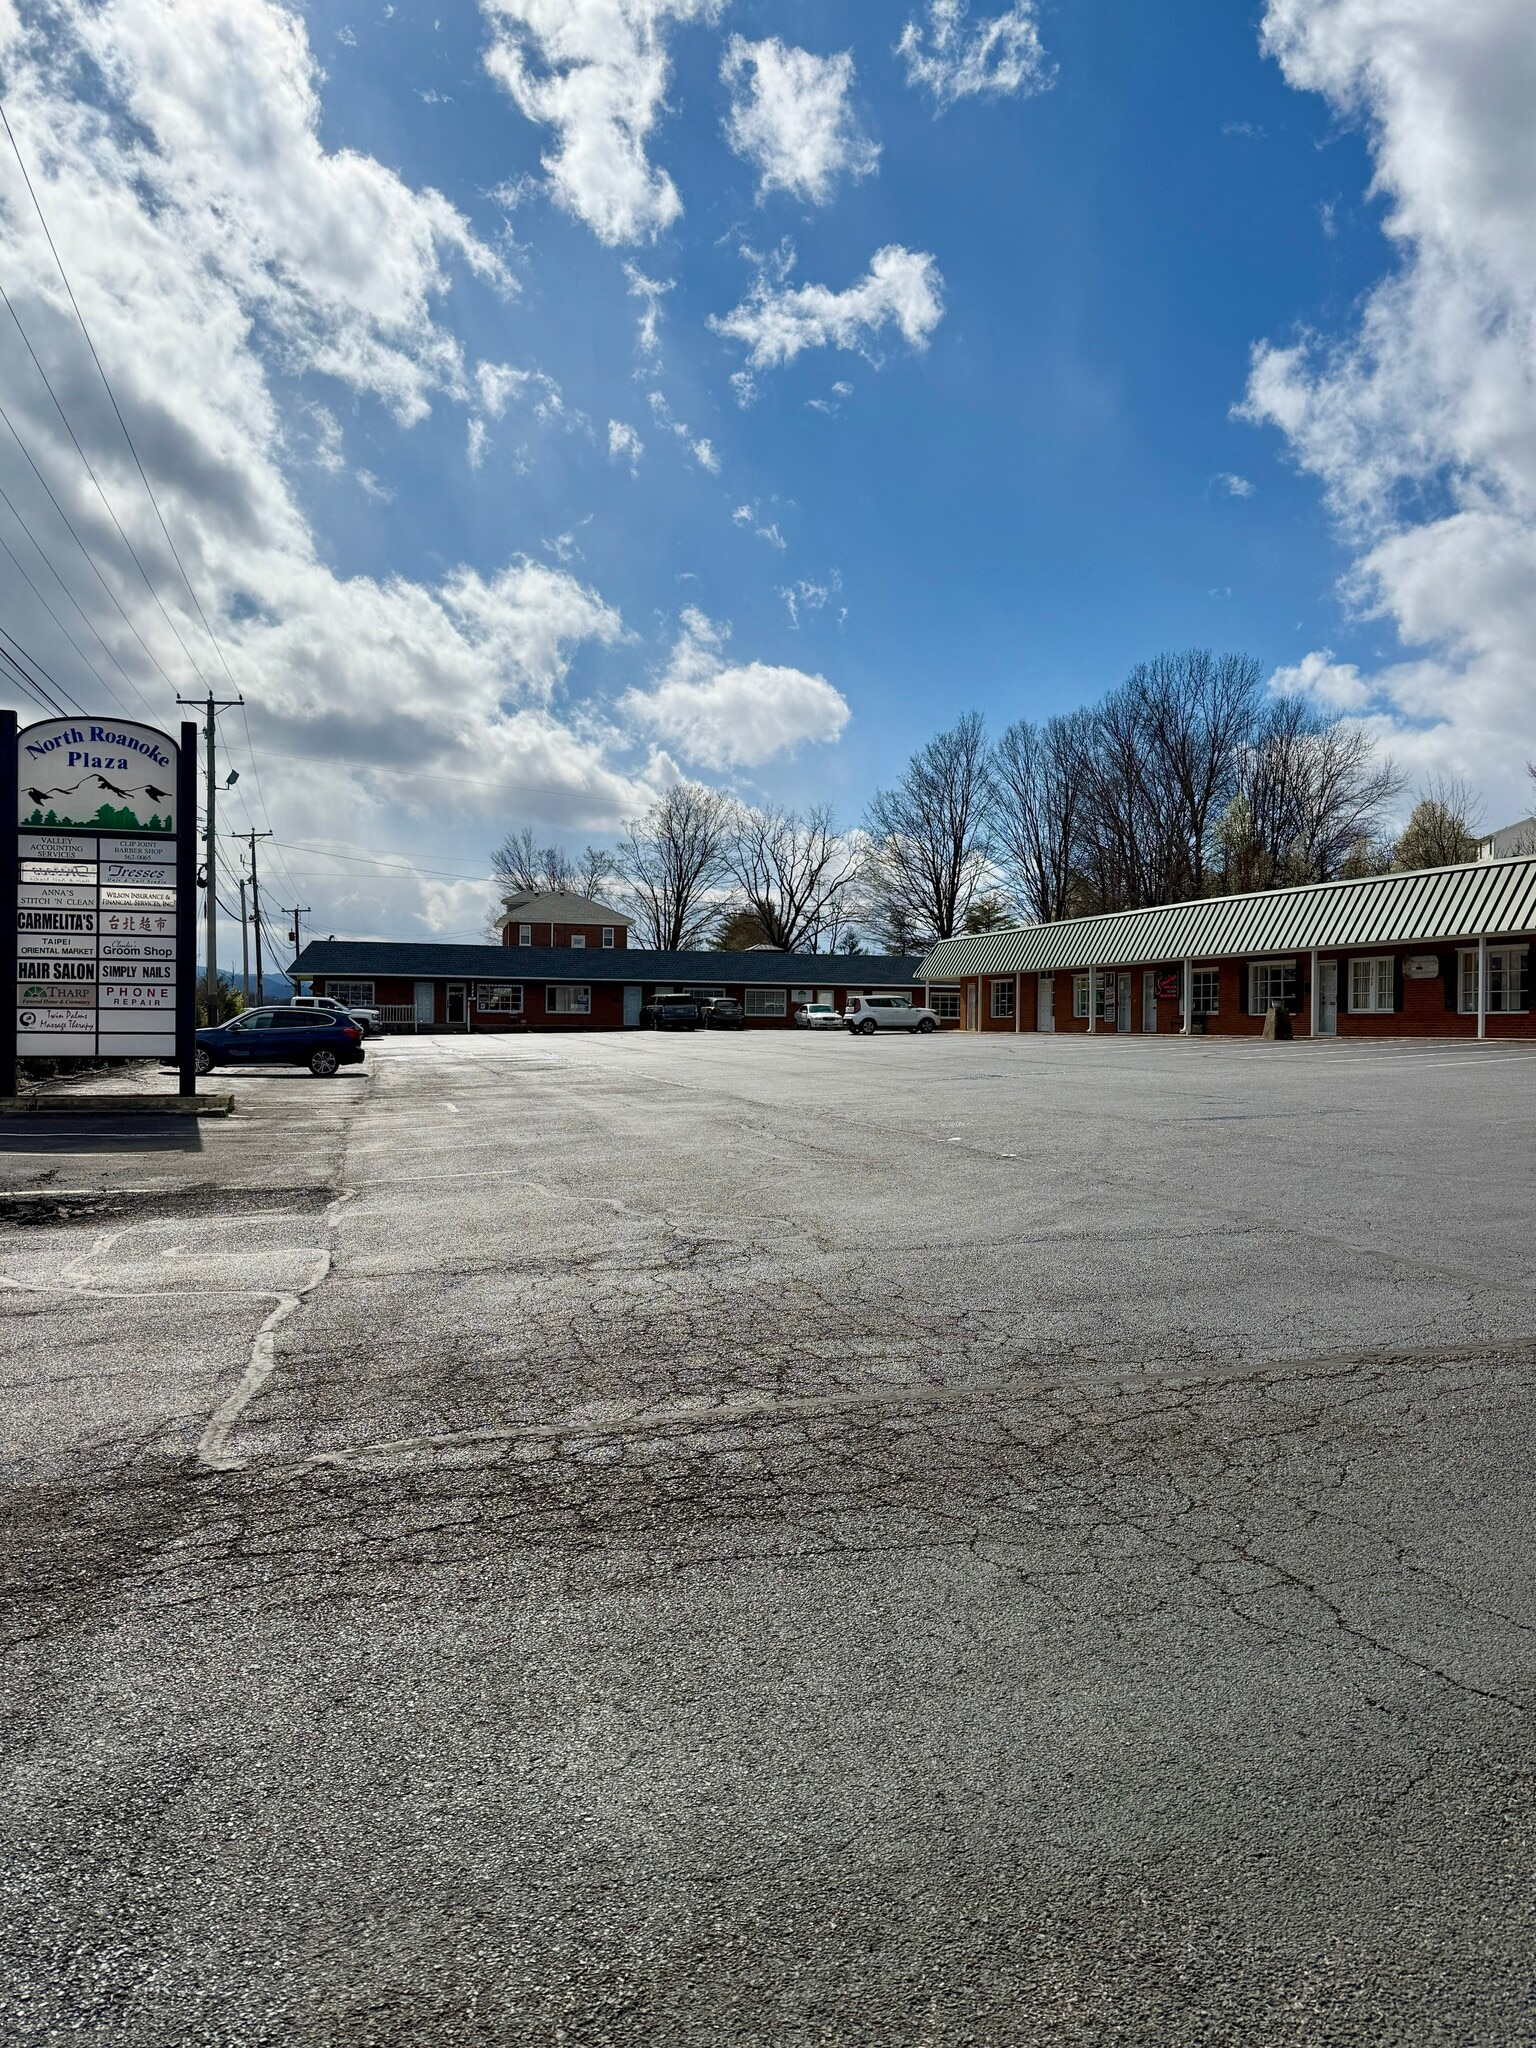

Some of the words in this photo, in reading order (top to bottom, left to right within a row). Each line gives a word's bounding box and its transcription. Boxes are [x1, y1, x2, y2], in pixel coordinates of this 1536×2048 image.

[25, 728, 84, 760] North
[89, 726, 170, 768] Roanoke
[67, 752, 128, 770] Plaza
[108, 864, 165, 878] Tresses
[18, 912, 94, 930] CARMELITA'S
[108, 915, 167, 932] 台北超市
[103, 946, 140, 956] Groom
[144, 947, 172, 958] Shop
[19, 963, 50, 979] HAIR
[54, 963, 94, 979] SALON
[102, 966, 137, 978] SIMPLY
[143, 966, 170, 978] NAILS
[47, 986, 89, 997] THARP
[106, 987, 168, 997] PHONE
[47, 1010, 63, 1018] Twin
[66, 1011, 88, 1019] Palms
[40, 1020, 66, 1032] Massage
[68, 1020, 94, 1031] Therapy
